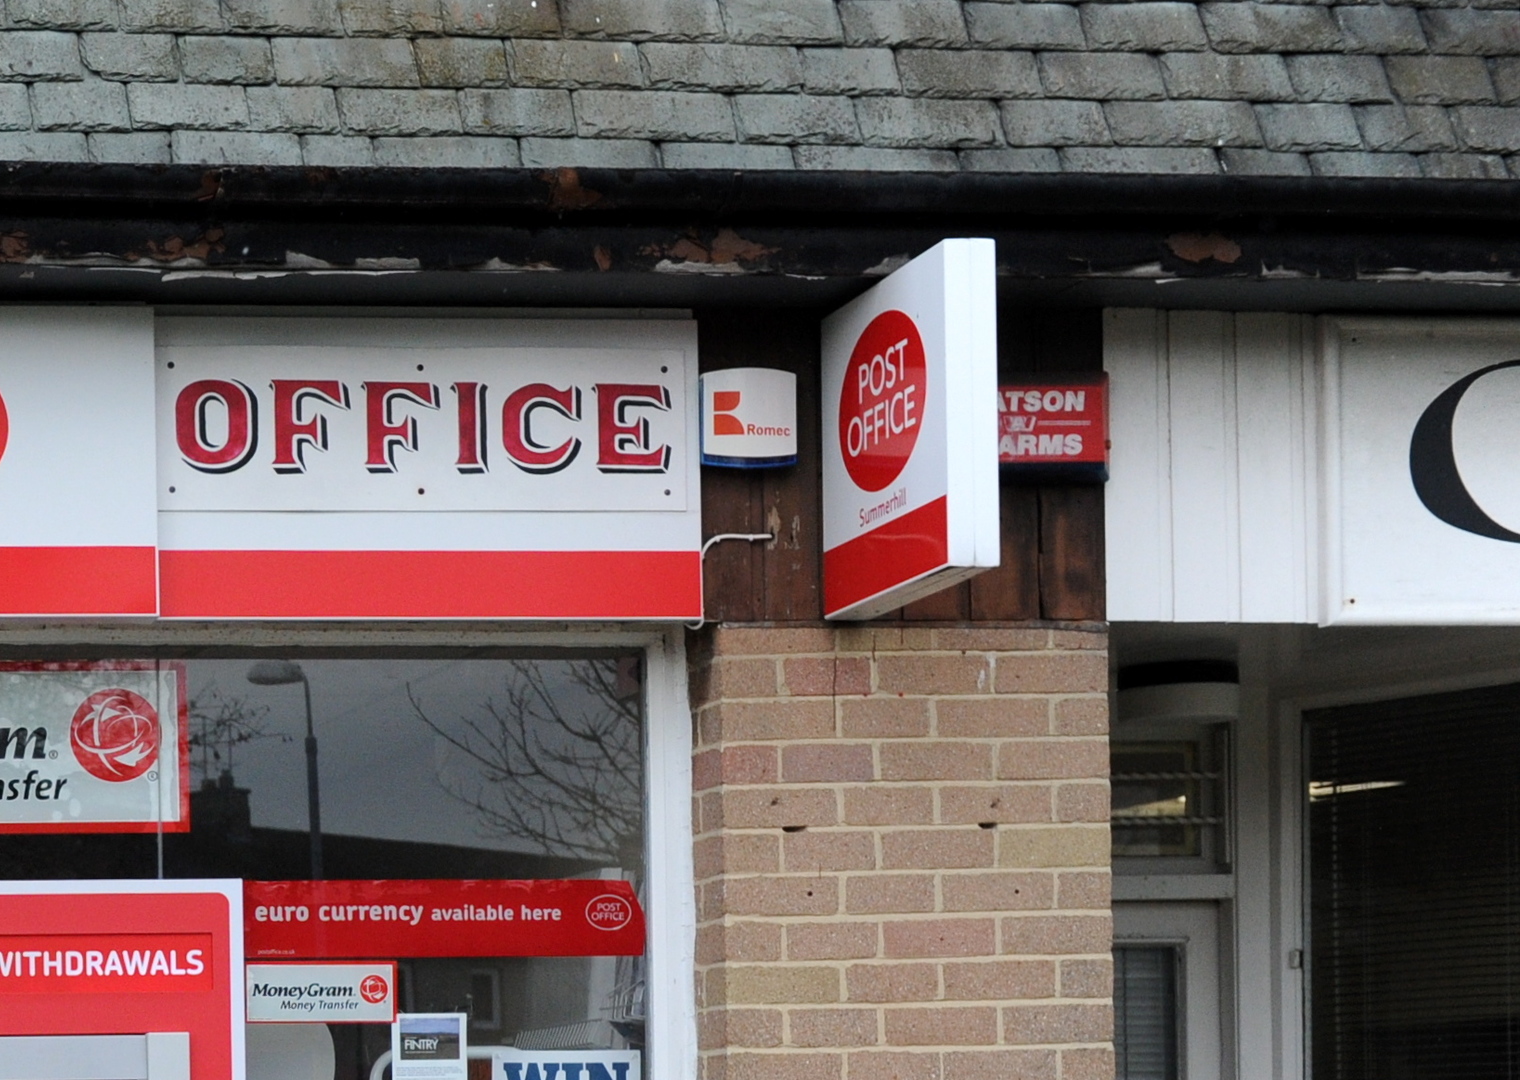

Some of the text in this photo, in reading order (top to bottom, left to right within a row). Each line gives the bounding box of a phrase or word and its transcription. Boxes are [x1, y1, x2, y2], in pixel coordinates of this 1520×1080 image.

[857, 338, 909, 405] POST
[174, 377, 673, 475] OFFICE
[846, 384, 917, 457] OFFICE
[746, 424, 791, 437] Romec
[859, 487, 907, 528] Summerhill
[254, 903, 562, 926] euro currency available here
[591, 912, 625, 922] OFFICE
[596, 903, 622, 912] POST
[252, 982, 355, 1001] MoneyGram
[280, 999, 359, 1012] Money Transfer
[404, 1038, 439, 1051] FINTRY
